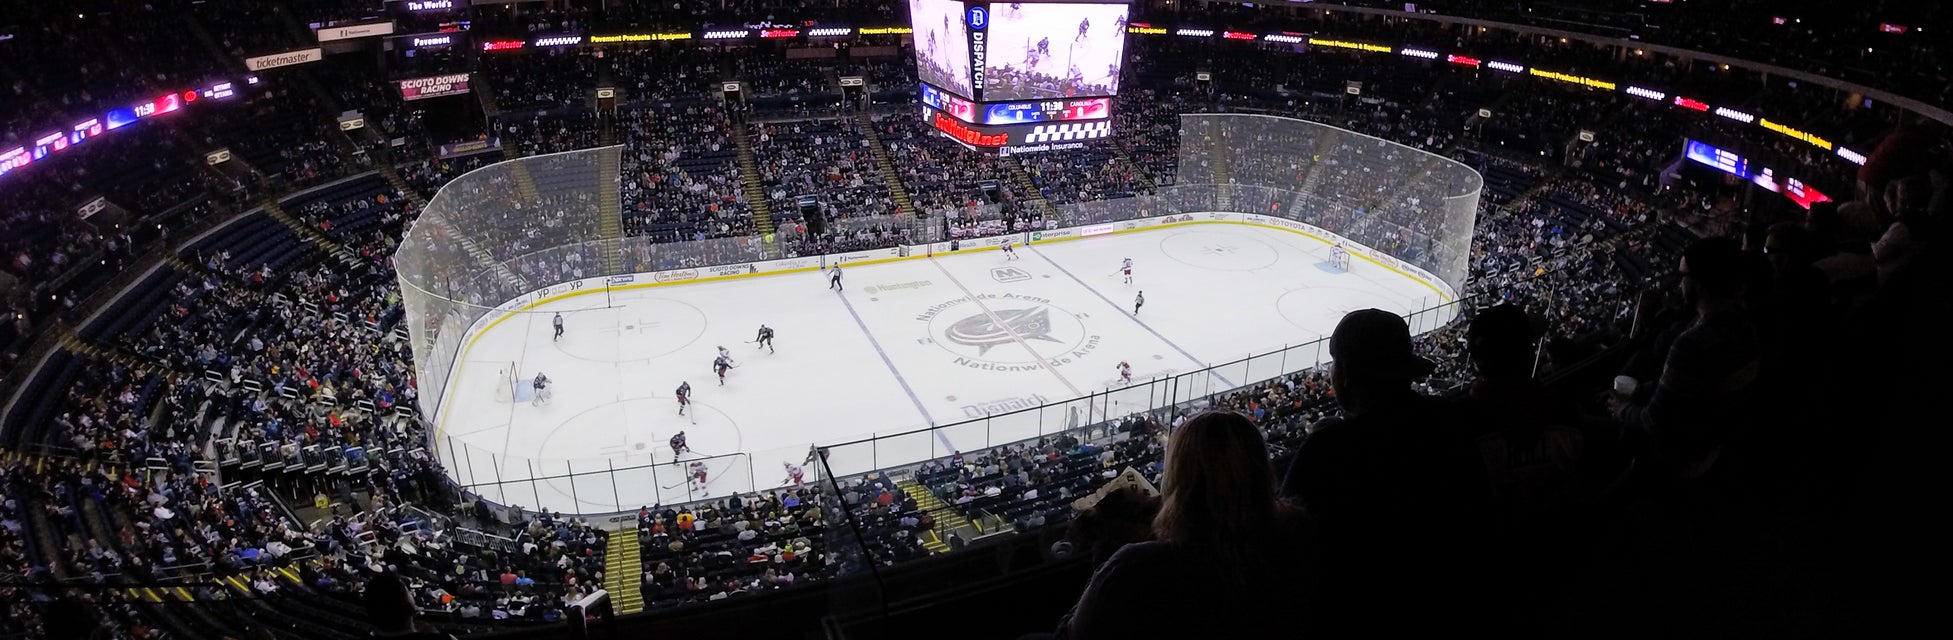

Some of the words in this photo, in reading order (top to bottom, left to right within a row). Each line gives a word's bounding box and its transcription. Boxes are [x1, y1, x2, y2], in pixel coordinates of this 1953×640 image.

[408, 2, 423, 10] The
[414, 36, 450, 46] Pavement
[591, 35, 621, 43] Pavement
[658, 32, 691, 41] Equipment
[1309, 38, 1334, 46] Pavement
[1335, 40, 1358, 49] Products
[1363, 43, 1391, 52] Equipment
[256, 53, 309, 69] ticketmaster
[973, 32, 984, 89] DISPATCH
[401, 77, 434, 89] SCIOTO
[435, 73, 470, 85] DOWNS
[1529, 67, 1555, 78] Pavement
[1556, 72, 1579, 84] Products
[1585, 78, 1616, 90] Equipment
[134, 102, 155, 118] 11:38
[1040, 101, 1064, 111] 11:38
[1077, 107, 1084, 117] 0
[1016, 110, 1023, 120] 0
[1010, 144, 1050, 154] Nationwide
[1051, 141, 1083, 150] Insurance
[1280, 220, 1305, 231] TOYOTA
[1003, 292, 1051, 303] Arena
[1072, 334, 1100, 358] Arena
